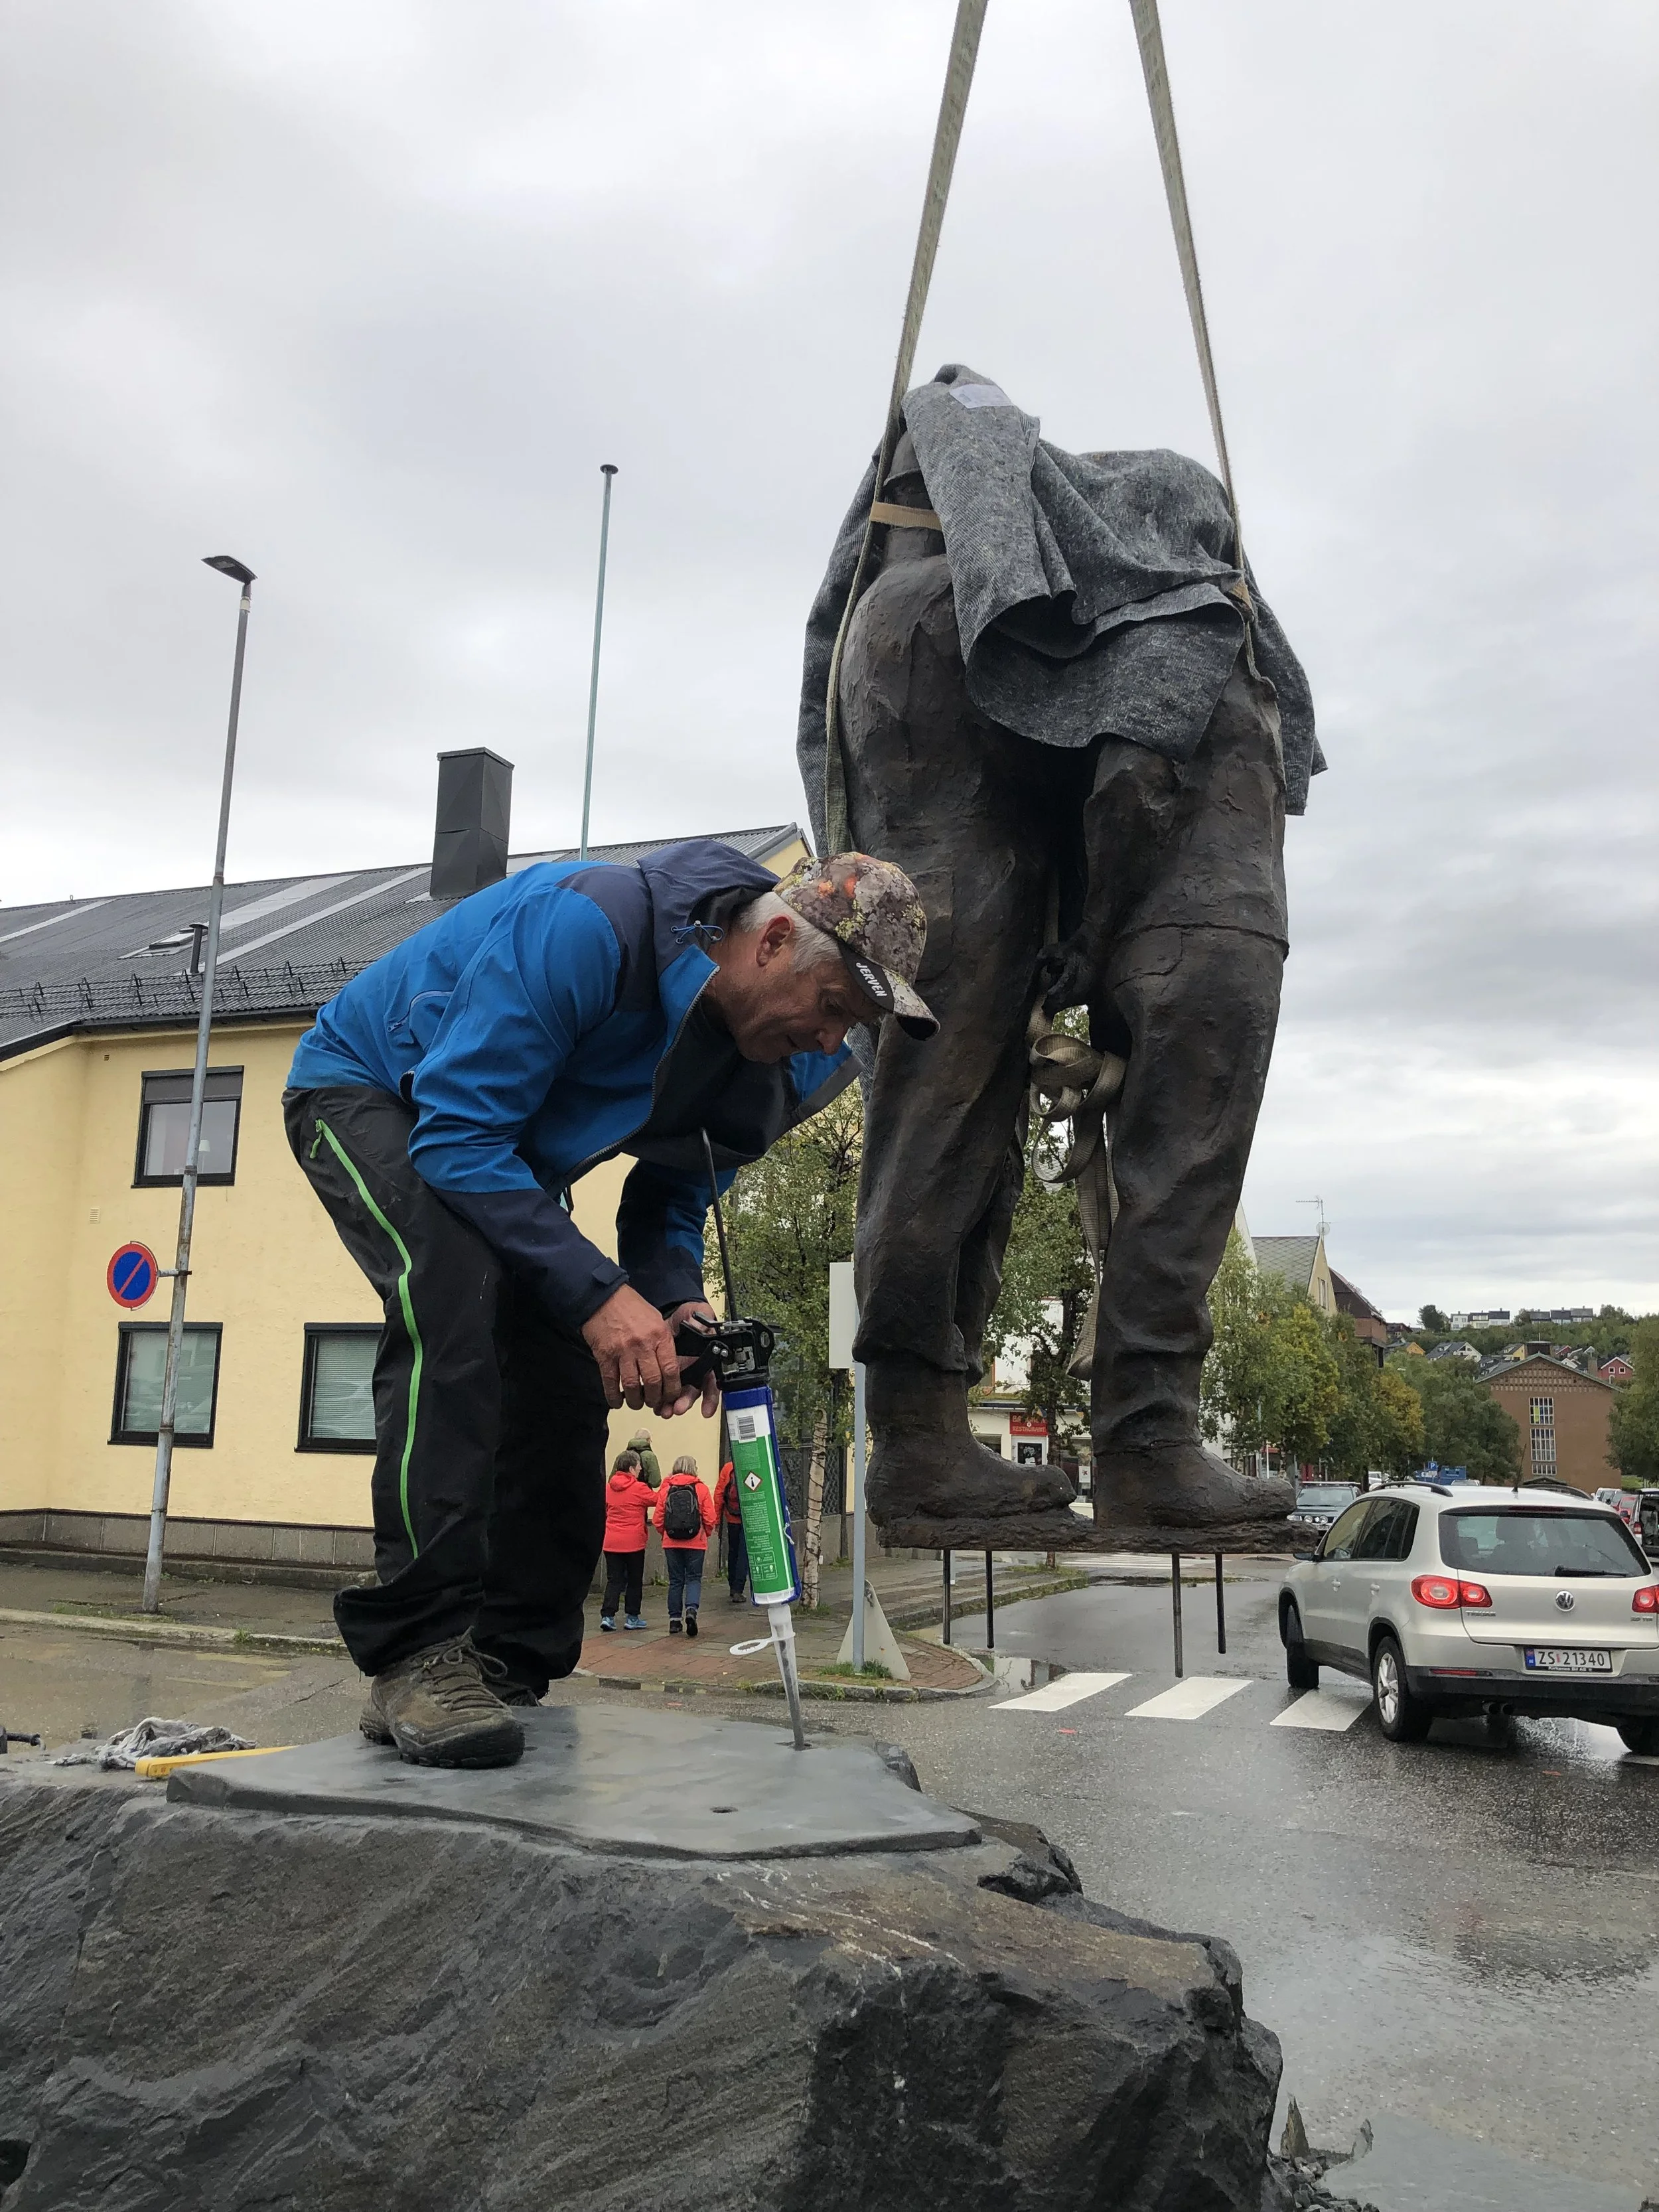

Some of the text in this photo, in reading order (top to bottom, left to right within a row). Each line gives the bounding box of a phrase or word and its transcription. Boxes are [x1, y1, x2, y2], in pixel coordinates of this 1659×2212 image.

[856, 962, 887, 997] JERVEN
[1538, 1651, 1605, 1666] ZS 21340
